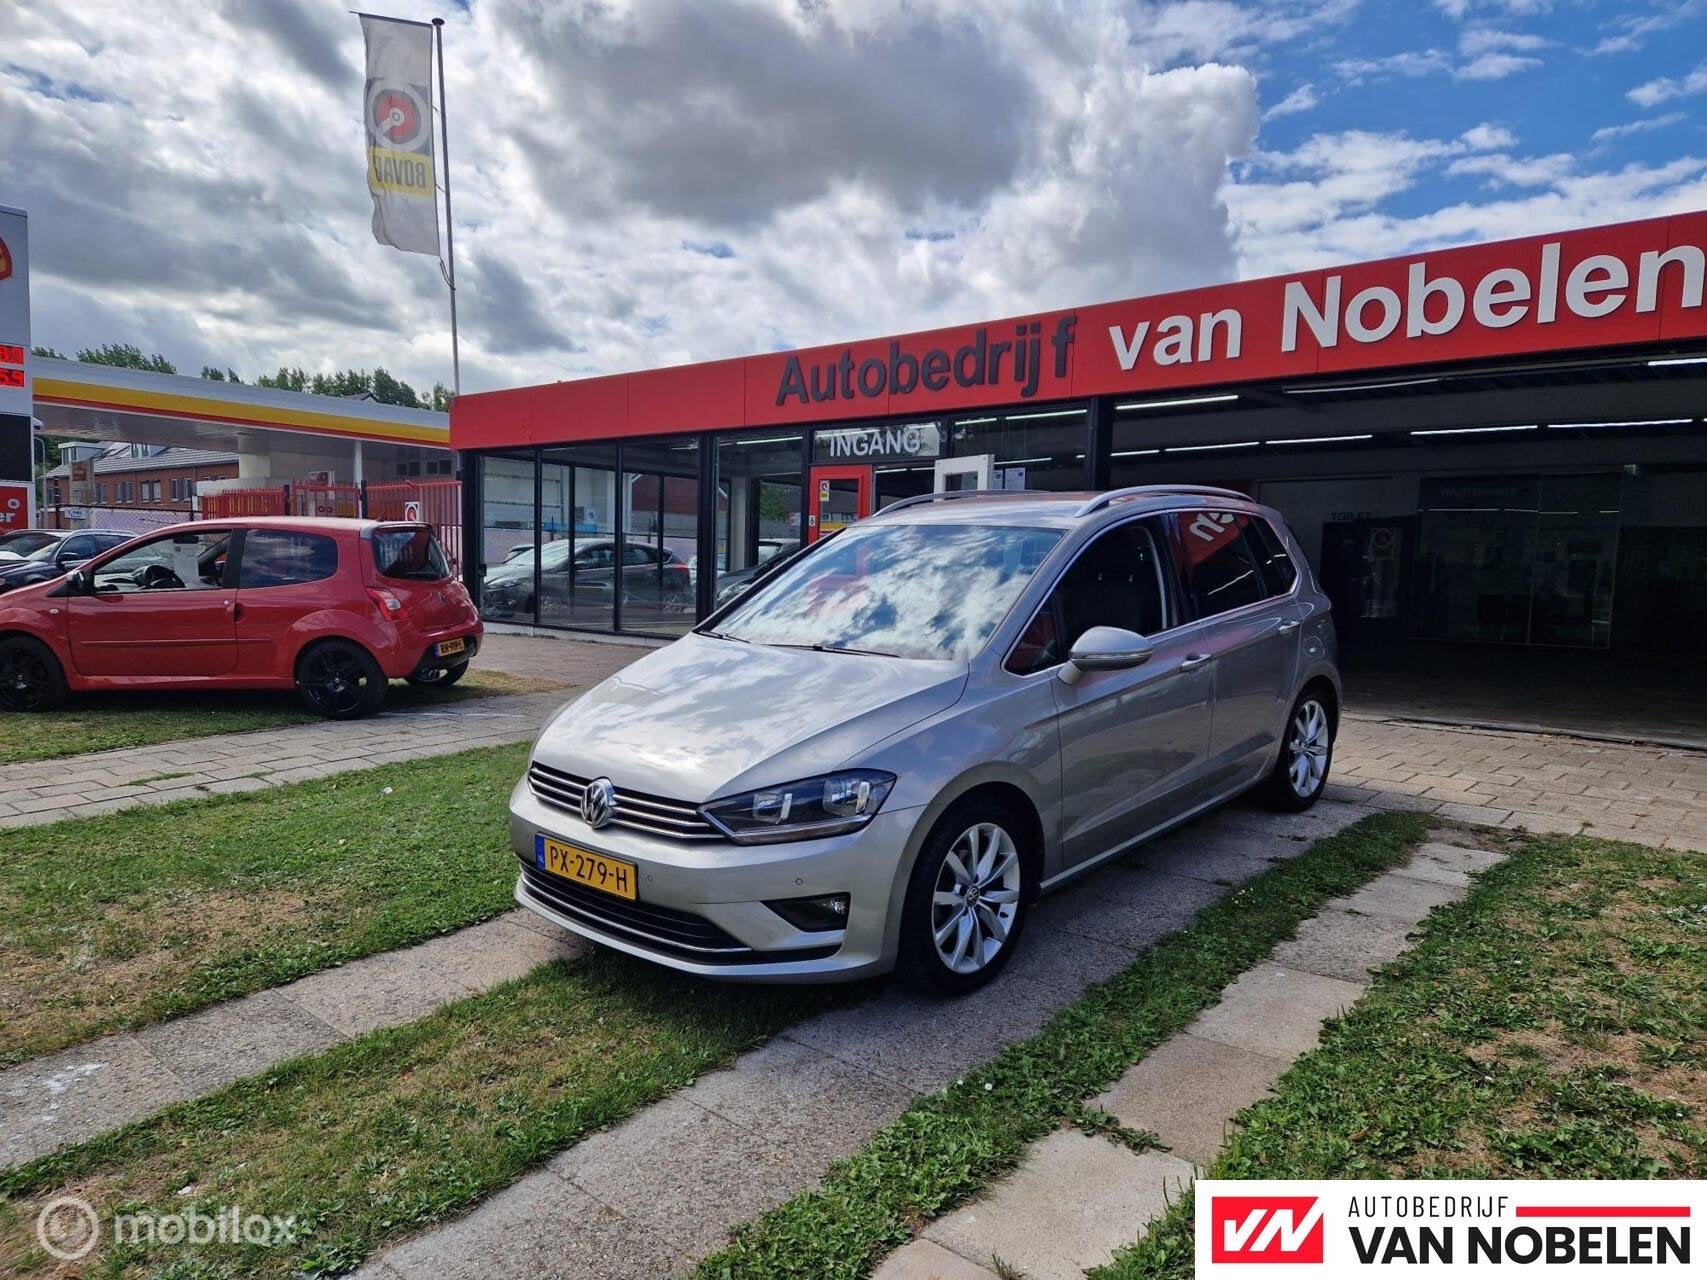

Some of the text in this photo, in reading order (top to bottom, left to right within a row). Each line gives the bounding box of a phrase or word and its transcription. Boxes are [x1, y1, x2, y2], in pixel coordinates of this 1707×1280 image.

[777, 242, 1705, 407] Autobedrijf van Nobelen
[829, 428, 922, 457] INGANG
[549, 845, 627, 892] PX-279-H
